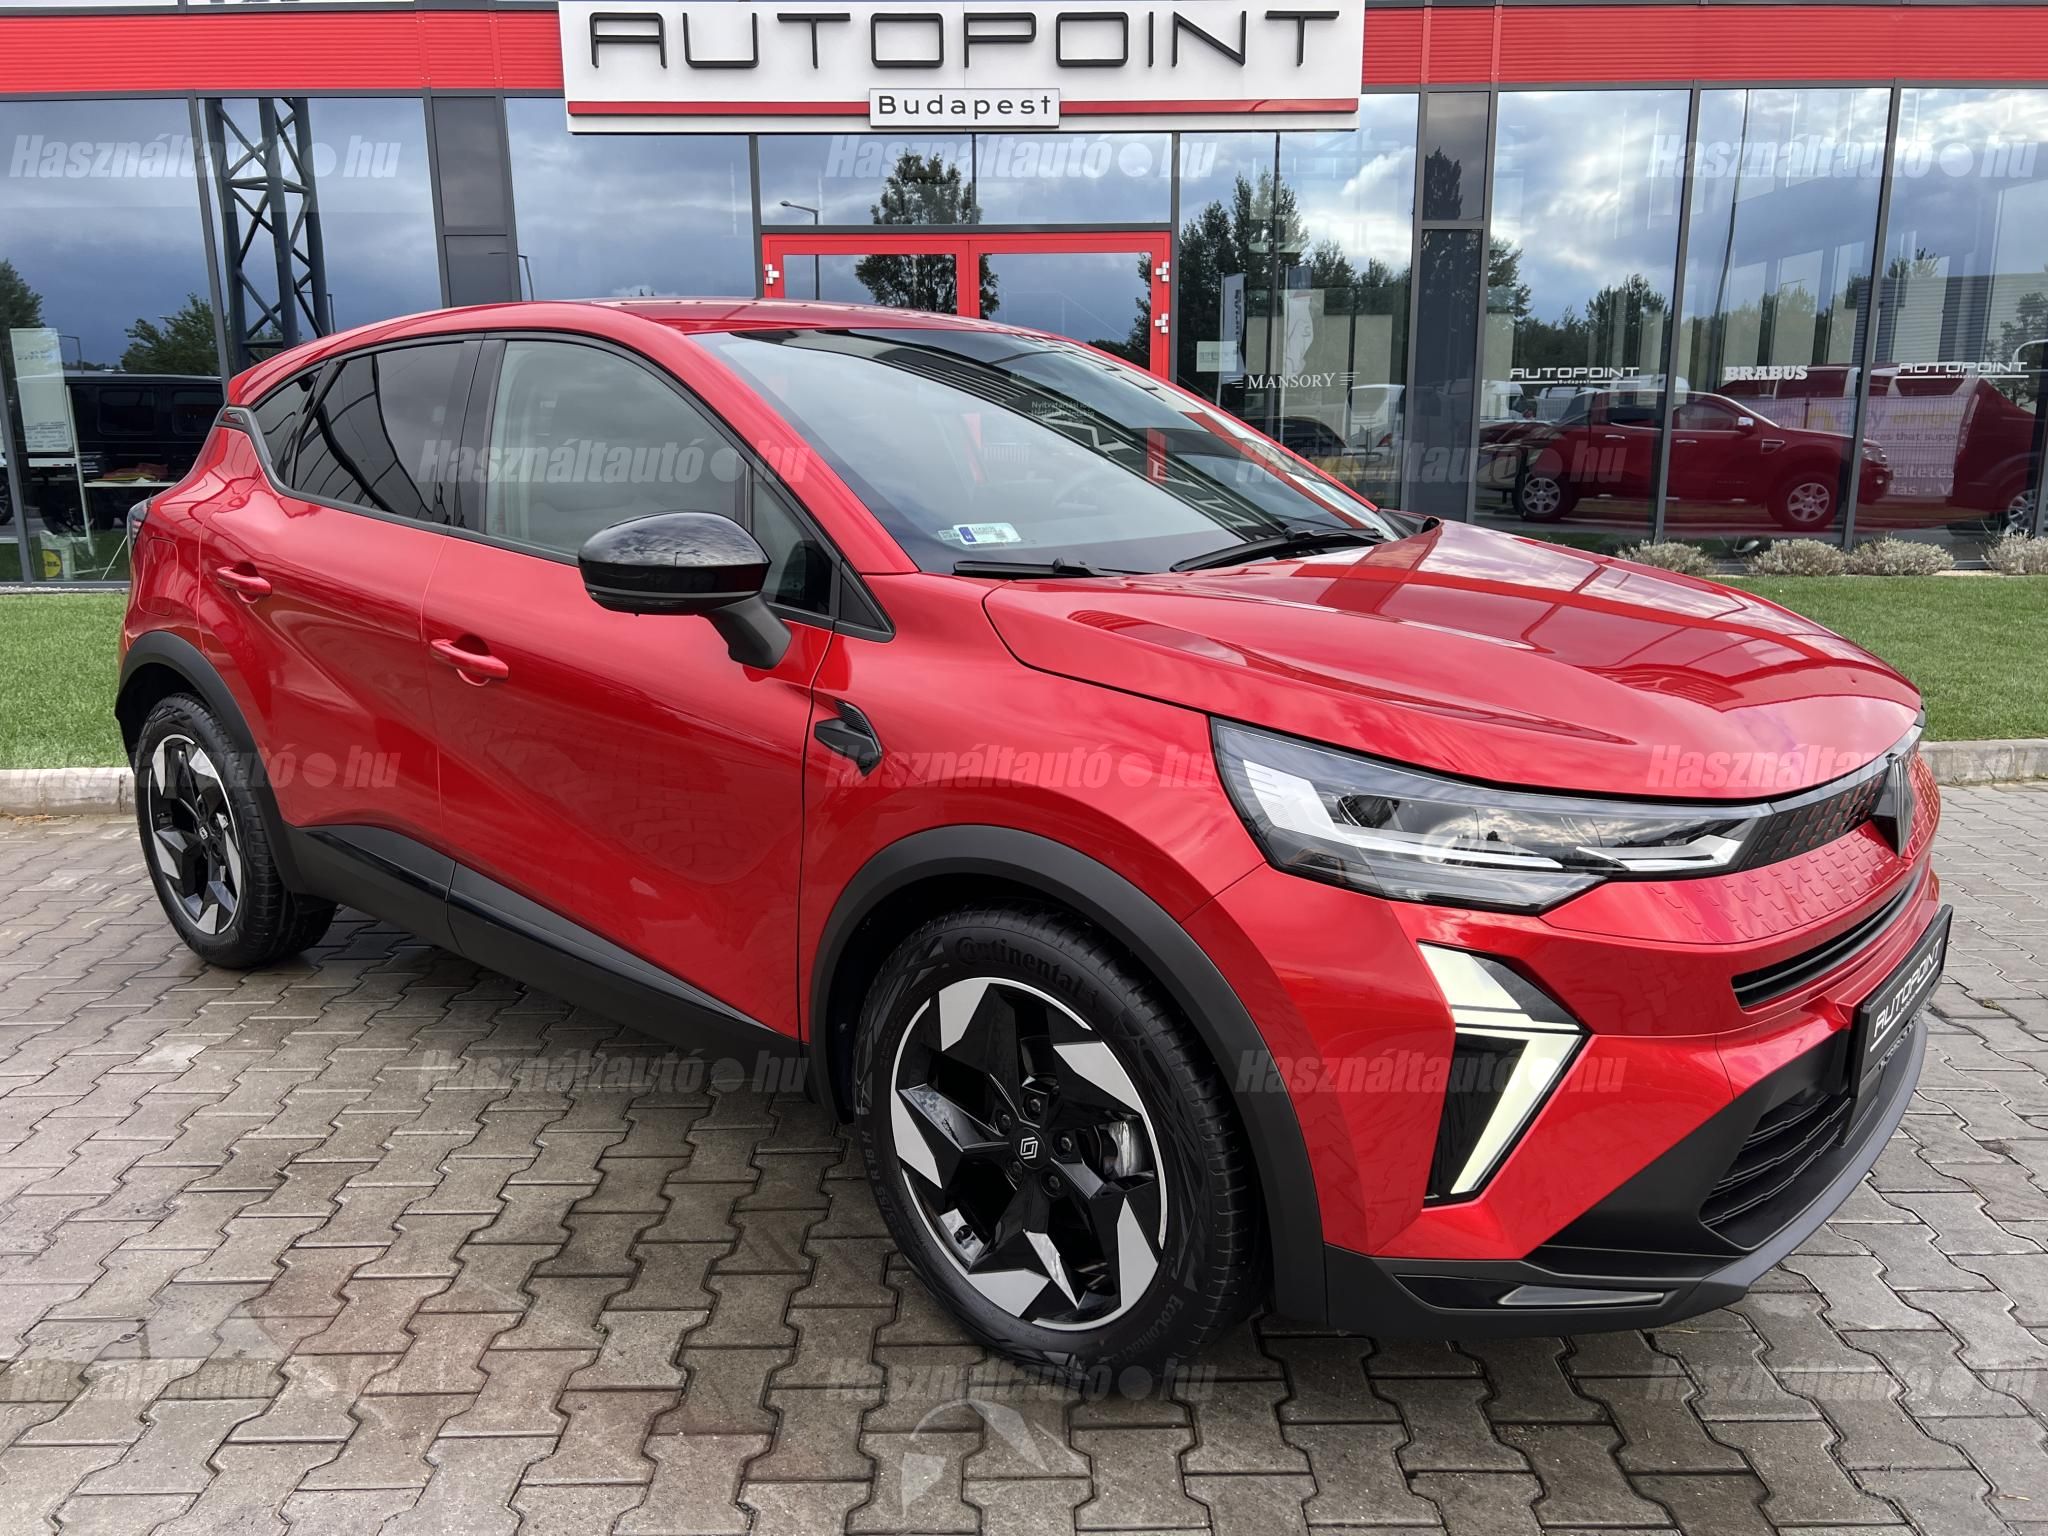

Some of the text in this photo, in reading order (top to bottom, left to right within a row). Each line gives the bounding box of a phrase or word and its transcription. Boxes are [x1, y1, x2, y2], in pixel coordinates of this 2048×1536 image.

[590, 10, 1340, 69] AUTOPOINT
[878, 94, 1051, 120] Budapest
[1509, 366, 1640, 379] AUTOPOINT
[1724, 365, 1808, 381] BRABUS
[1898, 361, 2028, 373] AUTOPOINT
[955, 936, 1084, 998] Continental
[1873, 937, 1942, 1038] AUTOPOINT
